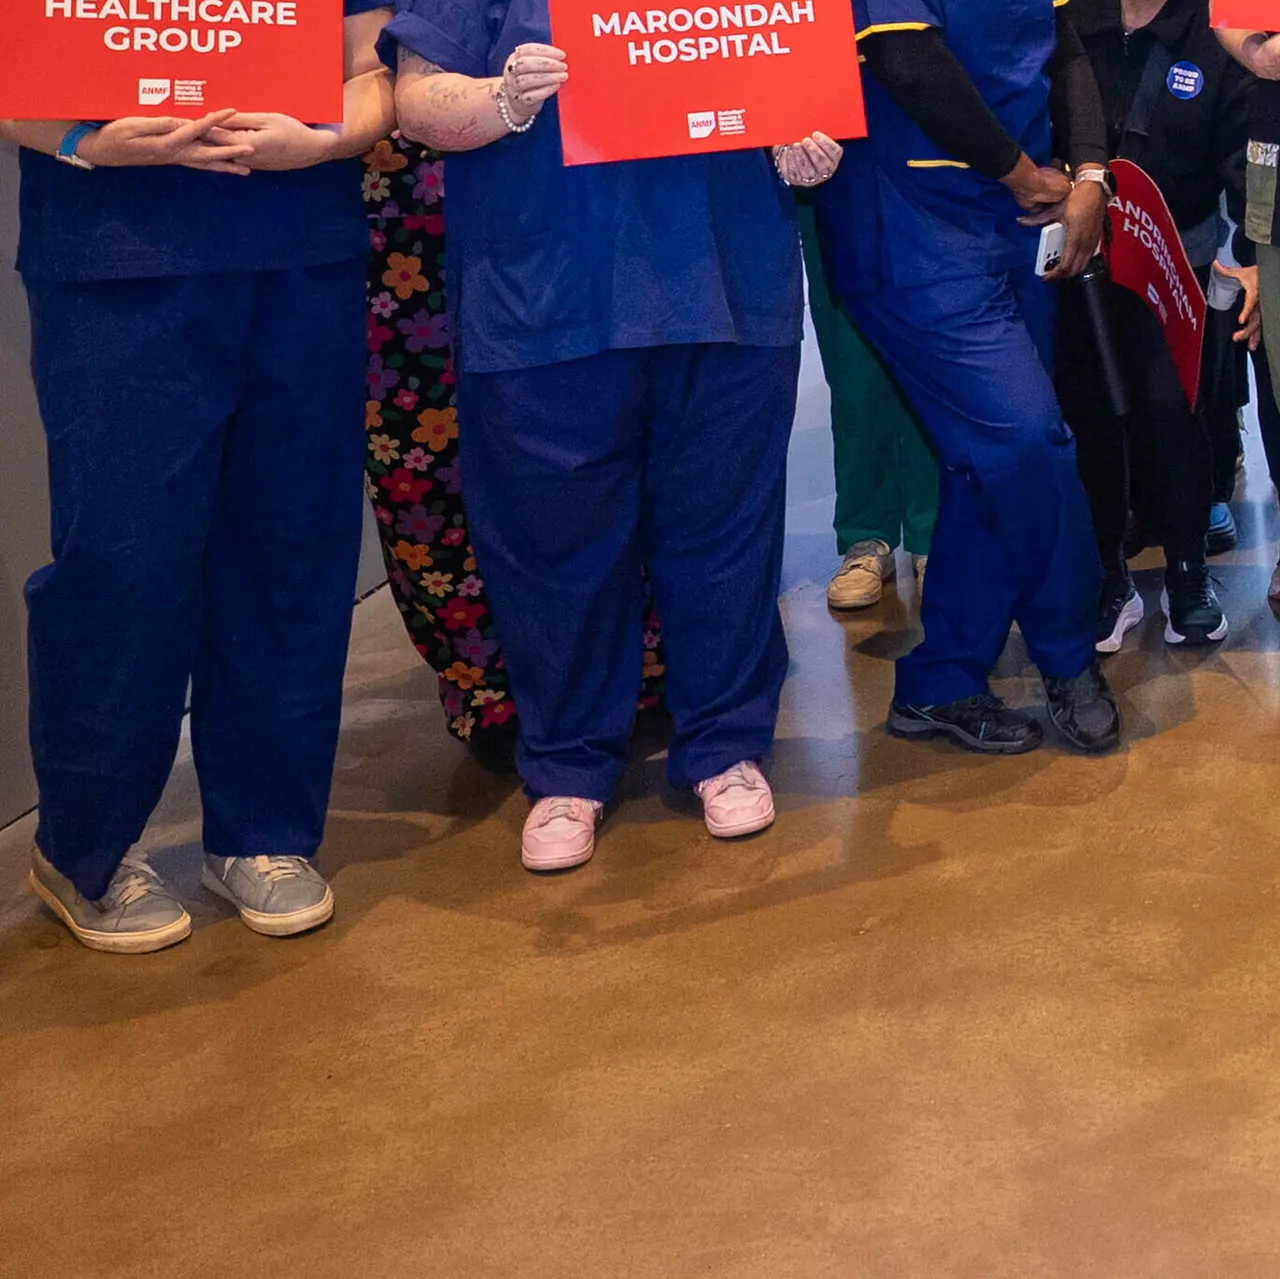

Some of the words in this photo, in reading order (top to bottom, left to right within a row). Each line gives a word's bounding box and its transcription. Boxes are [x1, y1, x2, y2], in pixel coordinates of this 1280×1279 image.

[592, 0, 815, 37] MAROONDAH
[103, 26, 242, 53] GROUP
[627, 31, 791, 65] HOSPITAL
[1173, 68, 1199, 78] PROUD
[1172, 83, 1195, 92] ANMF
